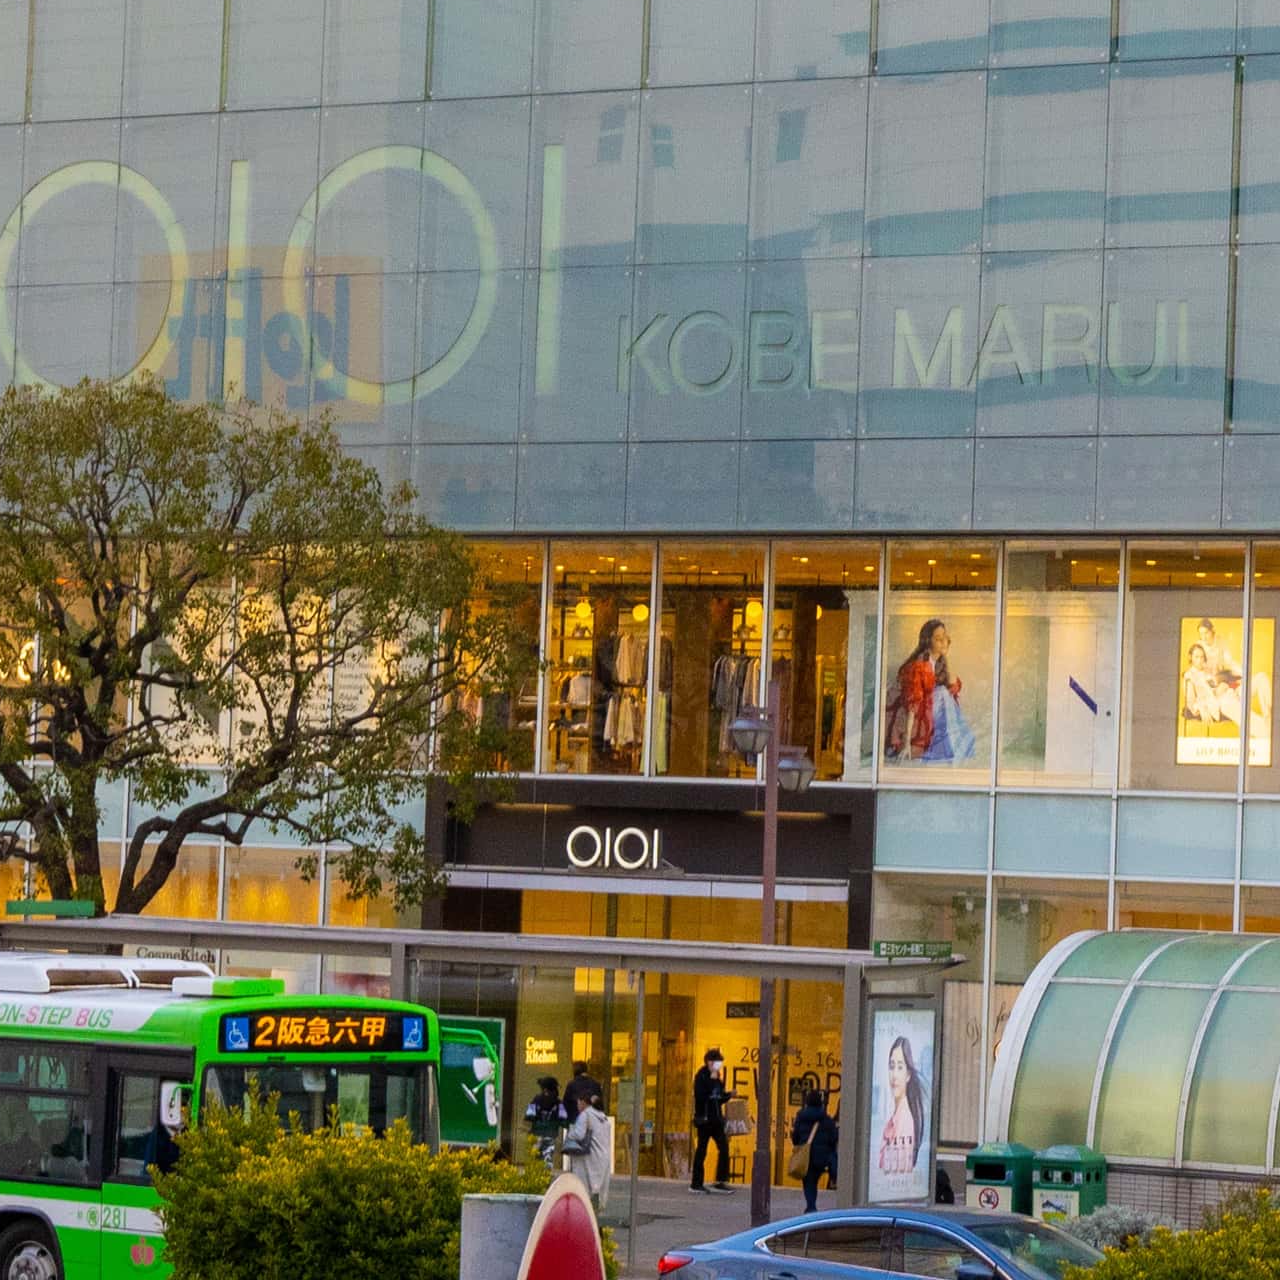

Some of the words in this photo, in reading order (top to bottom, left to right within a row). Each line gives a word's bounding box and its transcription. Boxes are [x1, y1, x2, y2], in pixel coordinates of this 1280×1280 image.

[616, 308, 858, 398] KOBE
[890, 300, 1190, 392] MARUI
[75, 1008, 114, 1028] BUS
